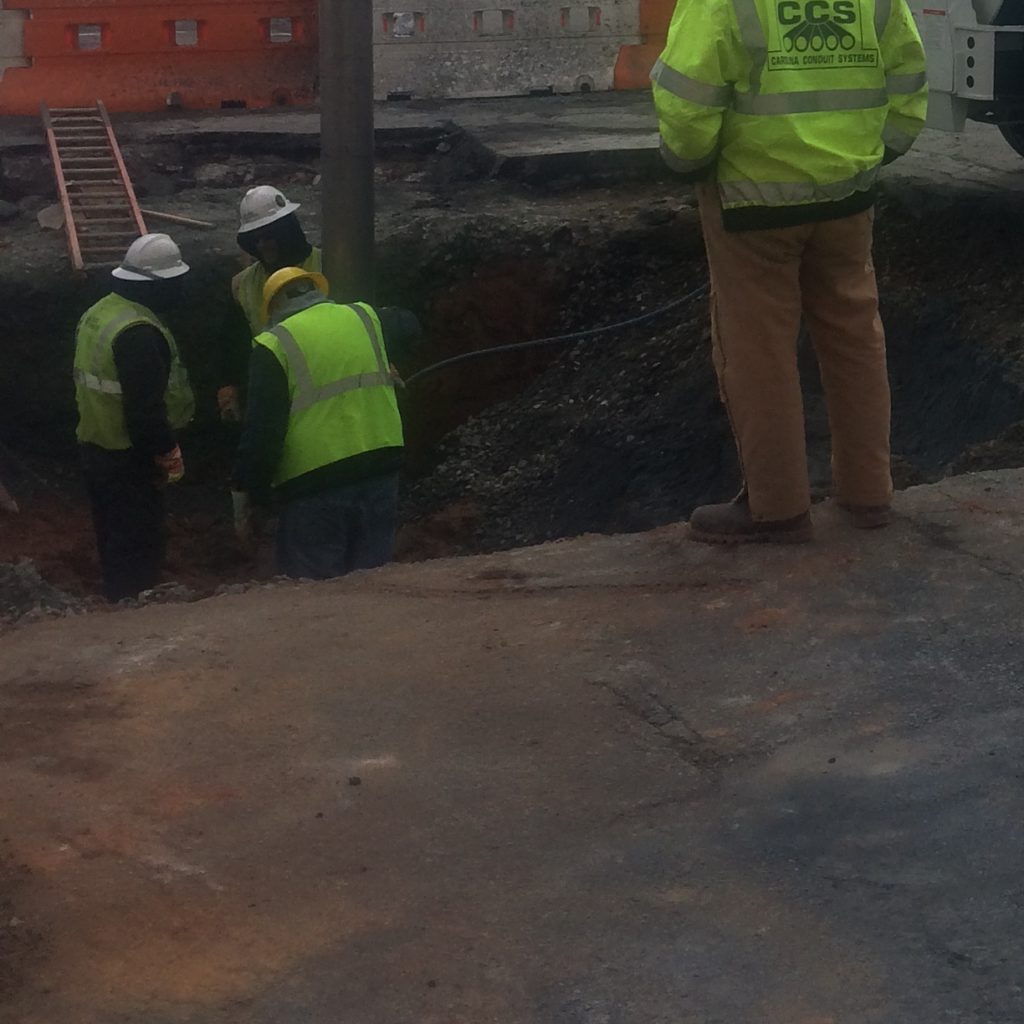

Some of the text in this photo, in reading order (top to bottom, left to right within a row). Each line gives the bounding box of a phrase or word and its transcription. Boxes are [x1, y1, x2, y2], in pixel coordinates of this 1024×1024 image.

[778, 0, 856, 25] CCS
[771, 54, 875, 66] CARNA CONDUIT SYSTEMS
